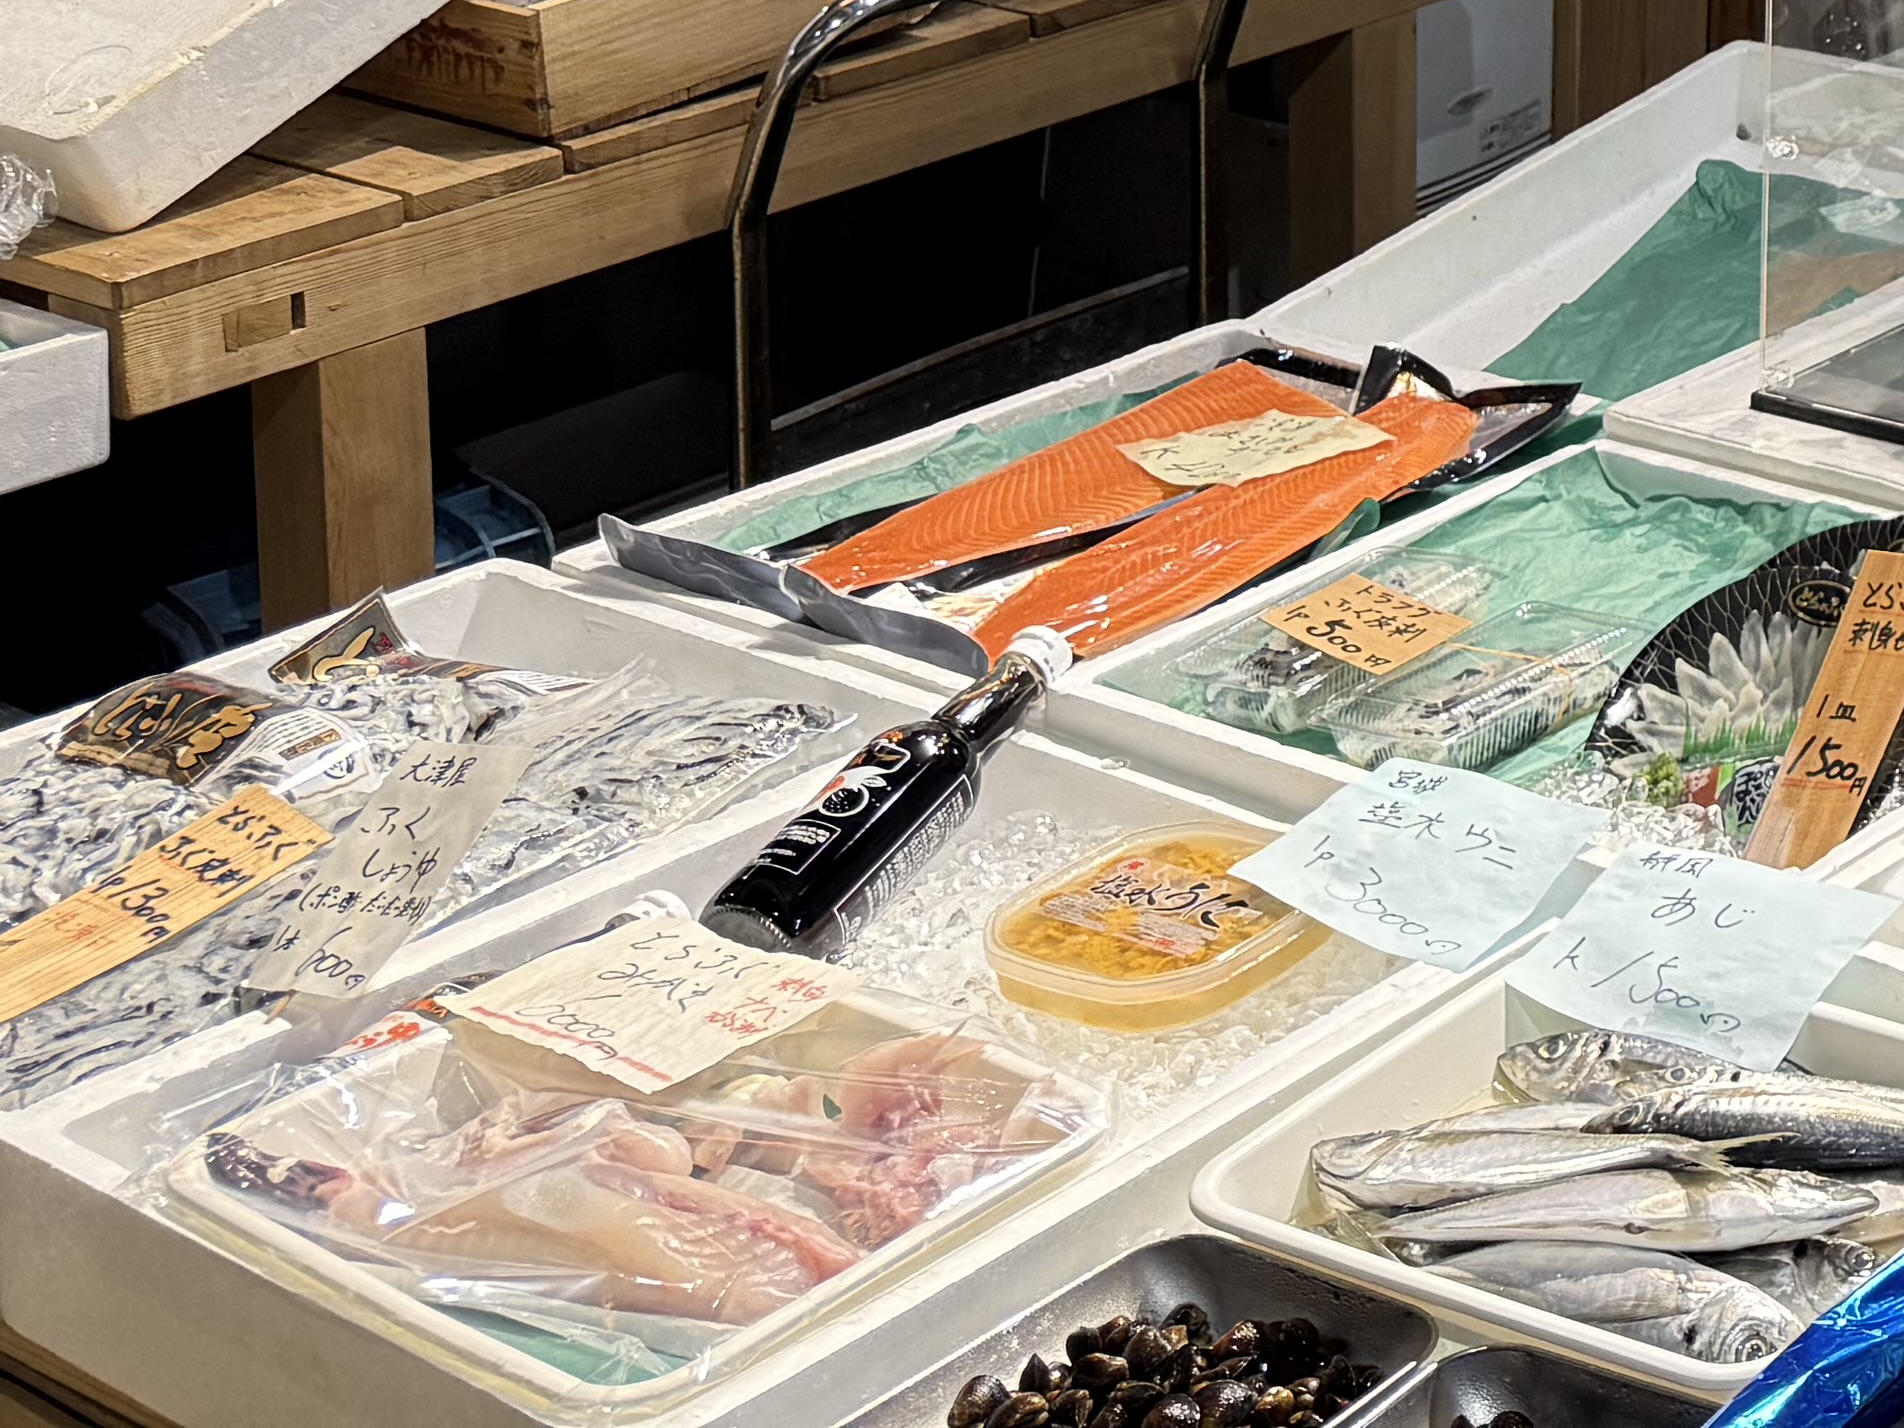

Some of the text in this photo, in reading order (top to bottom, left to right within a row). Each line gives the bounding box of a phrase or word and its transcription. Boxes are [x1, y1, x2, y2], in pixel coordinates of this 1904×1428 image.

[1306, 618, 1392, 668] 500円
[1815, 694, 1857, 724] 1皿
[400, 753, 478, 788] 大津屋
[1786, 735, 1866, 795] 1500円
[361, 806, 432, 840] ふく
[362, 847, 441, 894] しょうゆ
[1324, 867, 1462, 955] 3000円
[1650, 888, 1755, 929] あじ
